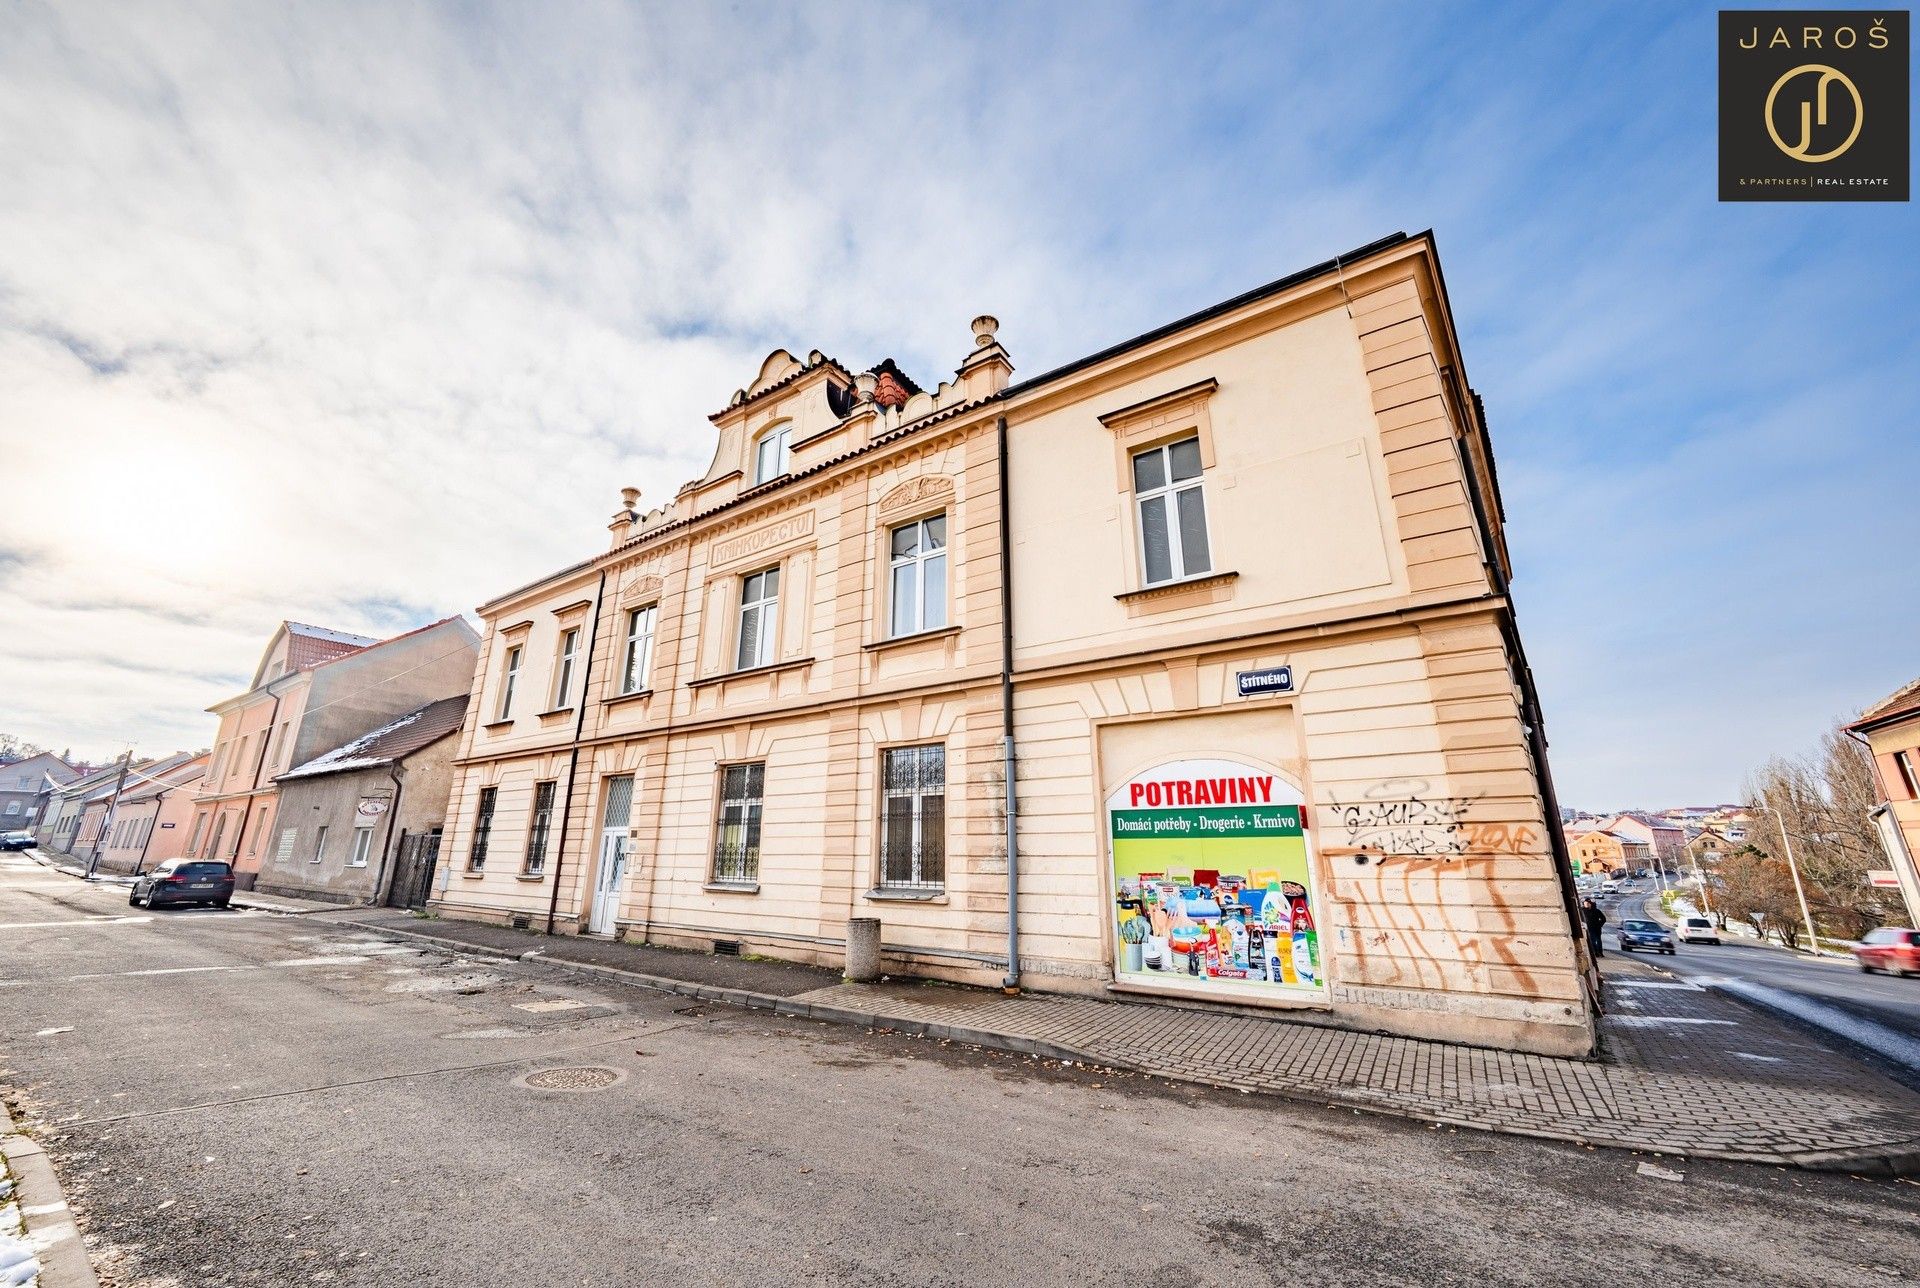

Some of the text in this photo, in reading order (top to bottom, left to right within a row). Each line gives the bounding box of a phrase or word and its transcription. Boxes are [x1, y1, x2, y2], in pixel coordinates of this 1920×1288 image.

[1241, 673, 1288, 688] ŠTÍTNÉHO
[1130, 776, 1273, 807] POTRAVINY
[1117, 817, 1152, 831] Domácí
[1154, 817, 1191, 833] potřeby
[1199, 815, 1245, 831] Drogerie
[1253, 813, 1296, 829] Krmivo
